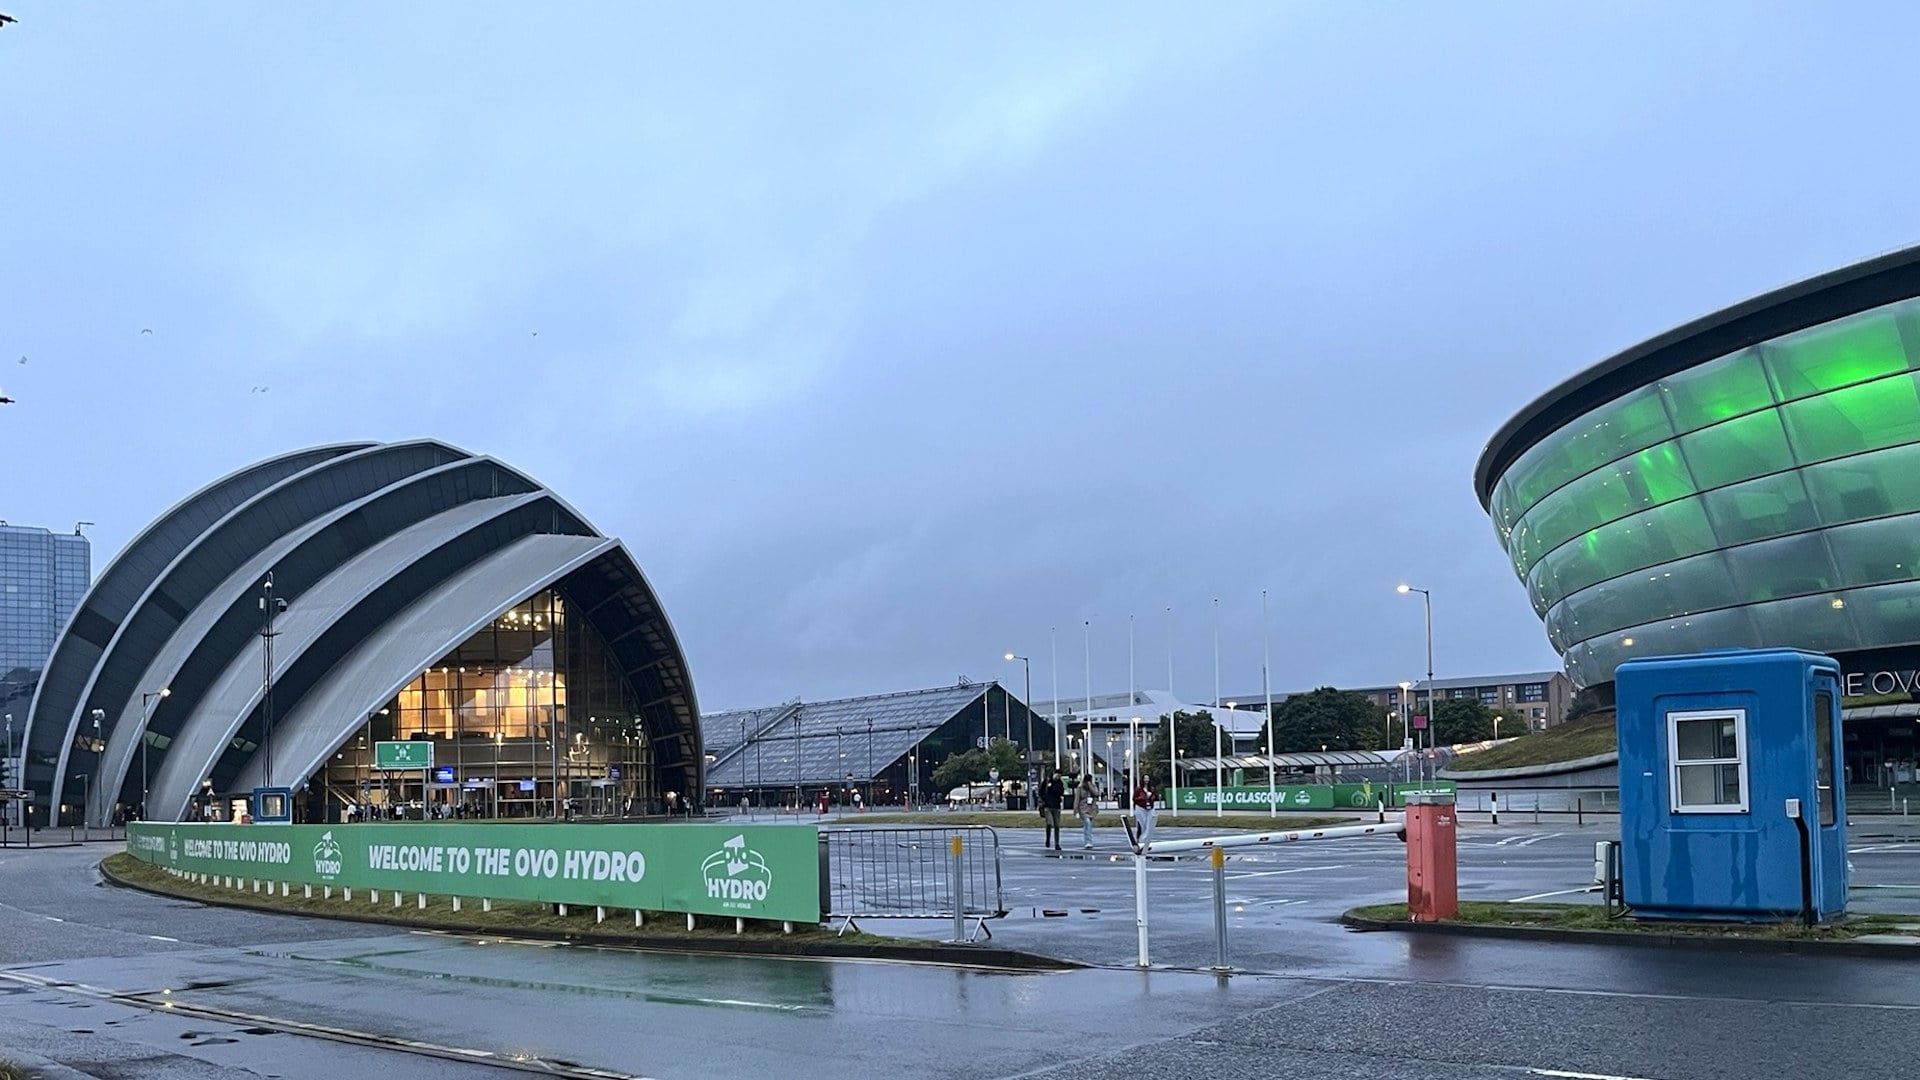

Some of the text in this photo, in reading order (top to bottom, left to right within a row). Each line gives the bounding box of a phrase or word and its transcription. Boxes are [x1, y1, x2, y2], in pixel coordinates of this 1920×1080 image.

[1204, 792, 1233, 804] HELO
[213, 840, 223, 859] TO
[224, 841, 238, 860] THE
[240, 841, 257, 862] OVO
[258, 842, 290, 864] HYDRO
[369, 845, 645, 883] WELCOME TO THE OVO HYDRO
[315, 860, 341, 874] HYDRO
[708, 877, 767, 901] HYDRO
